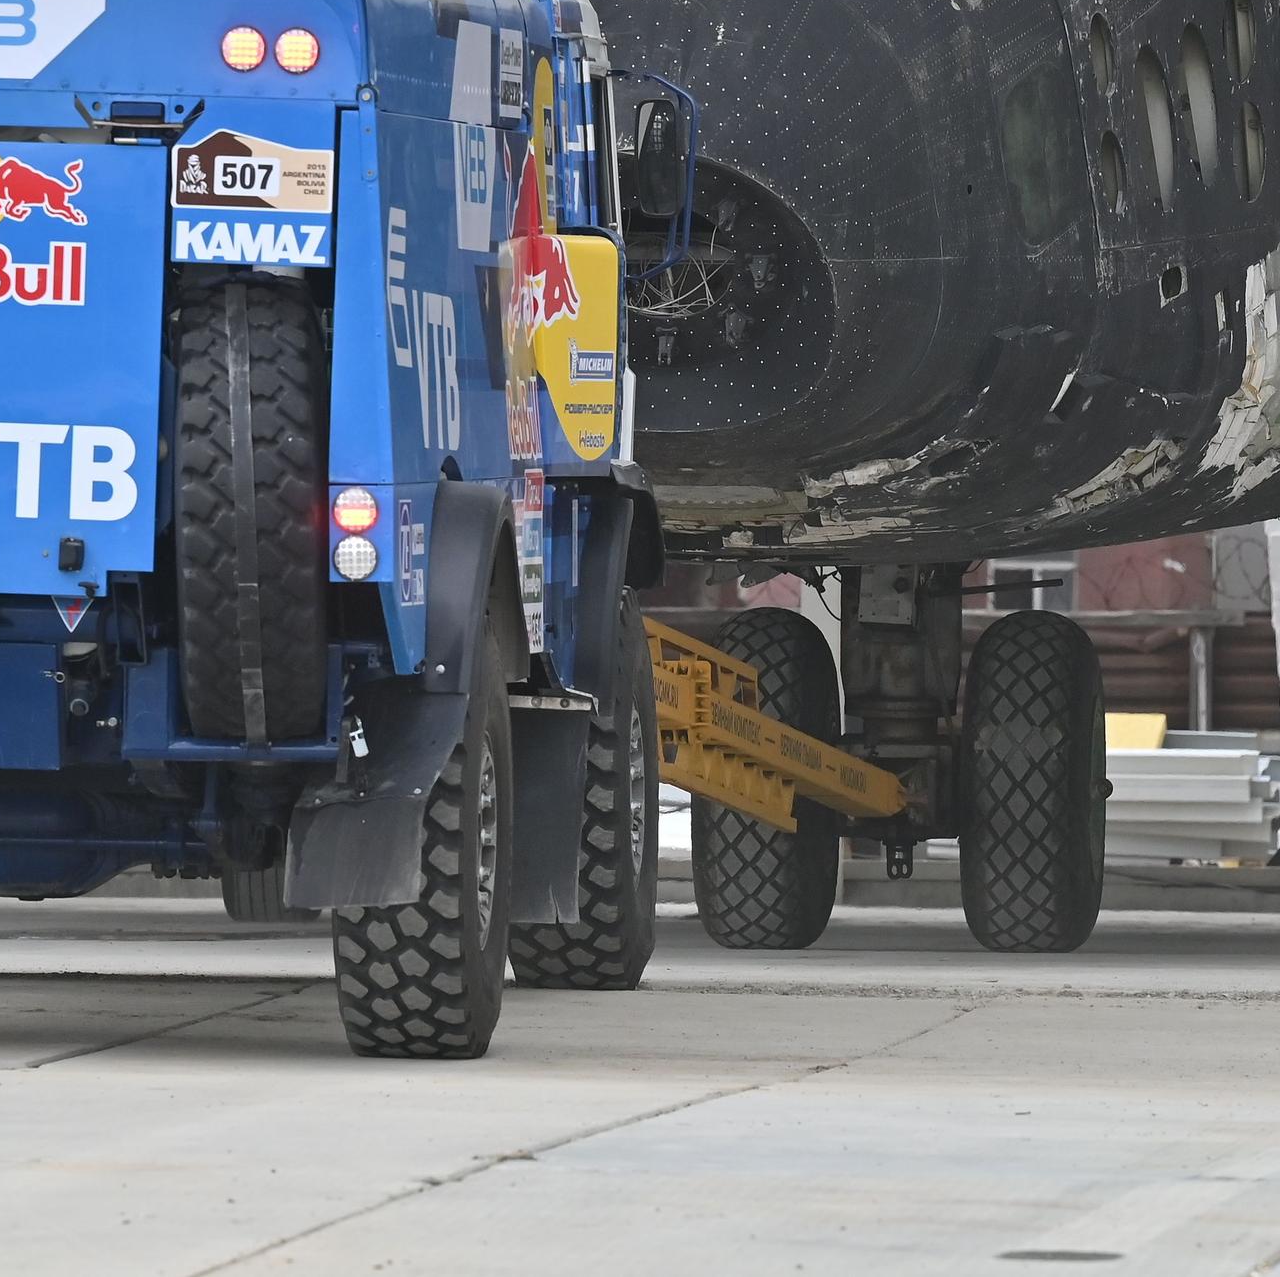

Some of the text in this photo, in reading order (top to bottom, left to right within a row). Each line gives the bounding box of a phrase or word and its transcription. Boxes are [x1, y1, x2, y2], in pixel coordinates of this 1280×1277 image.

[459, 123, 487, 204] VEB
[222, 163, 274, 190] 507
[282, 171, 326, 179] ARGENTINA
[180, 180, 208, 194] DAKAR
[296, 180, 325, 188] BOLIVIA
[303, 188, 325, 196] CHILE
[175, 221, 326, 264] KAMAZ
[412, 290, 461, 450] VTB
[578, 357, 613, 371] MICHELIN
[578, 428, 605, 448] Webasto
